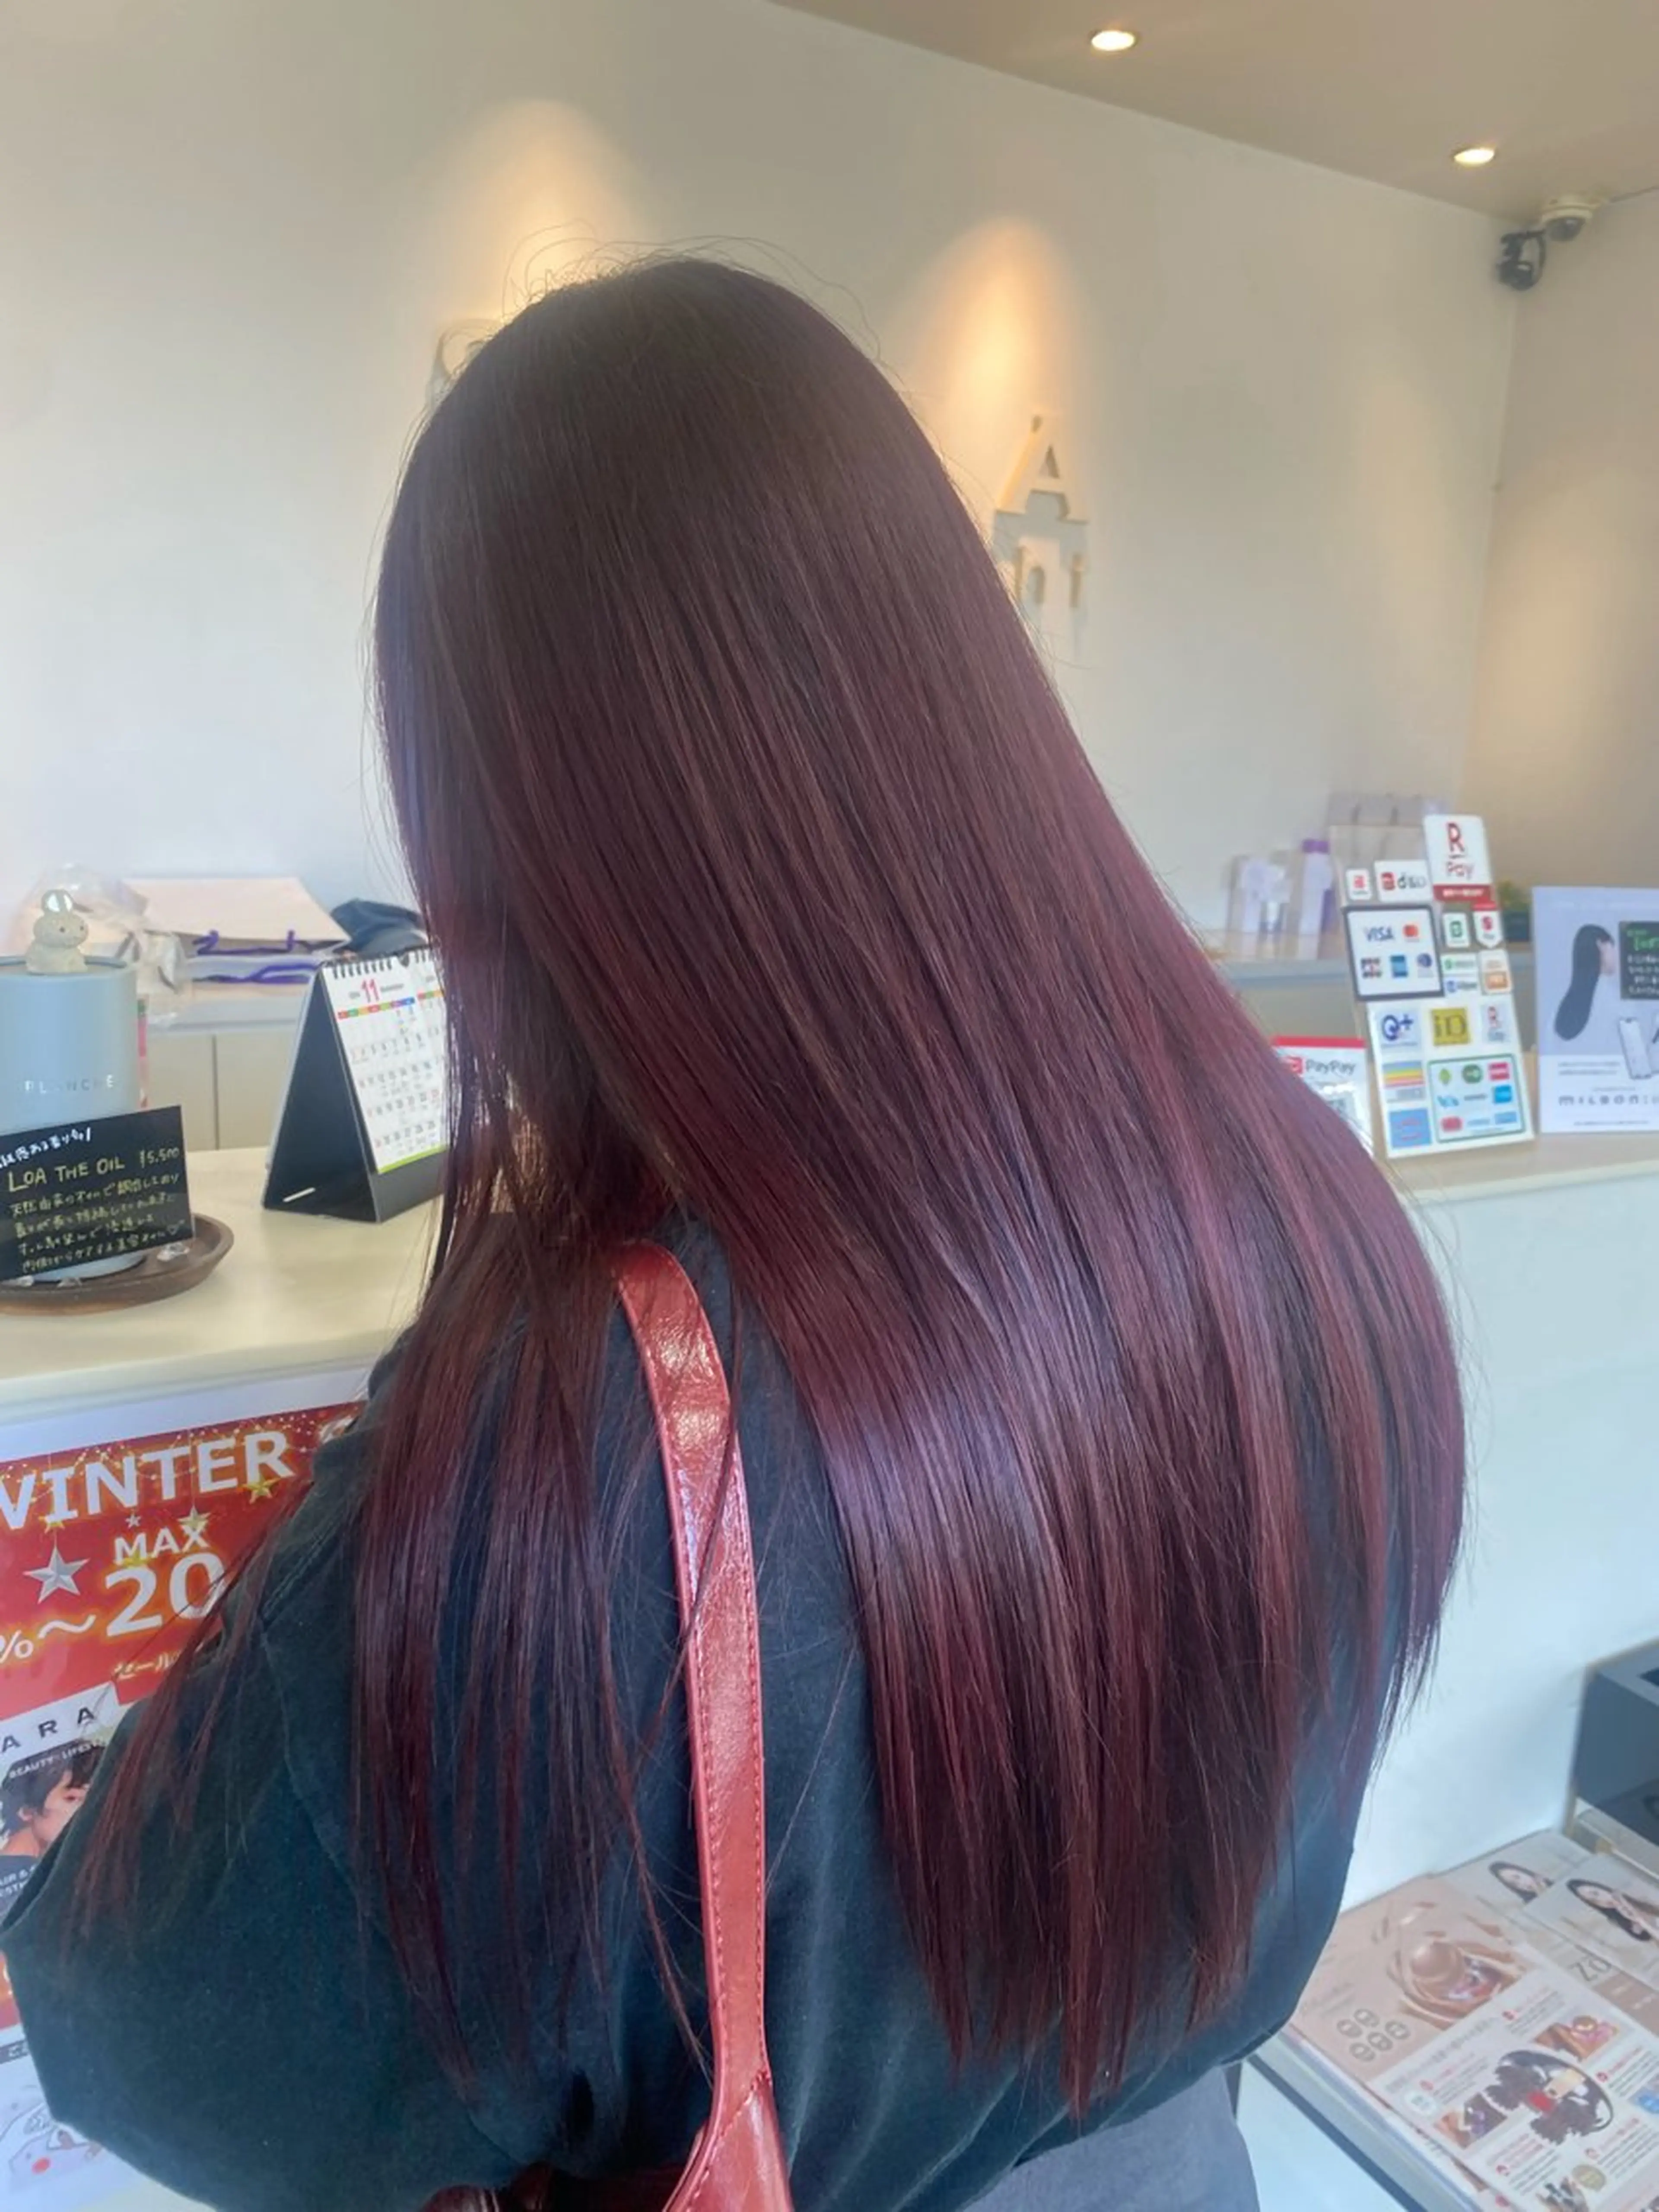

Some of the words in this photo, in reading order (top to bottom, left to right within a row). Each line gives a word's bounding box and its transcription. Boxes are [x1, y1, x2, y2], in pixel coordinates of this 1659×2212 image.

[1364, 925, 1396, 942] VISA
[361, 978, 380, 1003] 11
[1306, 1058, 1356, 1077] PayPay
[8, 1167, 47, 1192] LOA
[54, 1162, 89, 1183] THE
[96, 1156, 126, 1175] OIL
[114, 1524, 211, 1565] MAX
